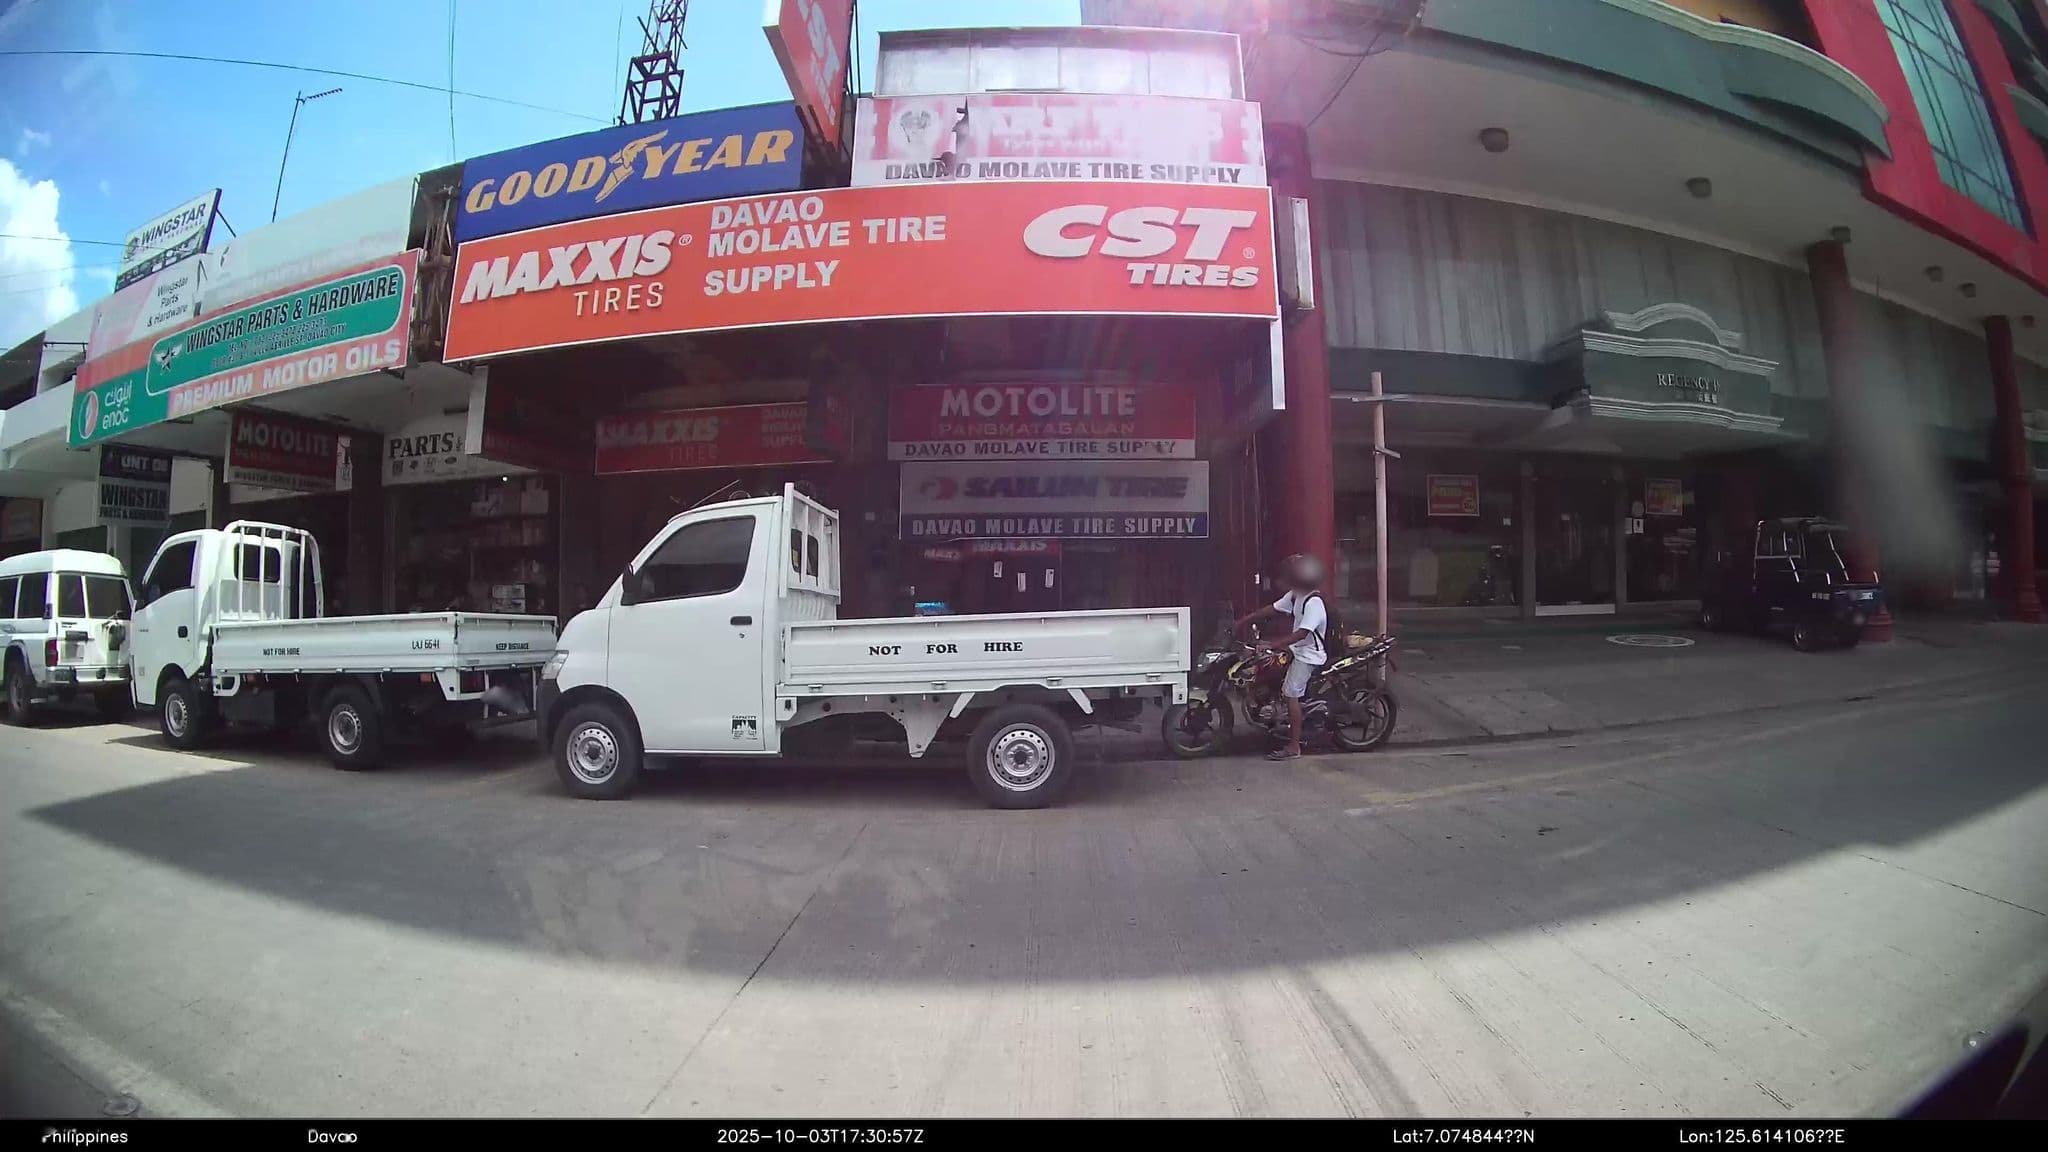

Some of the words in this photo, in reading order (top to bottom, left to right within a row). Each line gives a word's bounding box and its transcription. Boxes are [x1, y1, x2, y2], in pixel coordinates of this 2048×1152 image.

[979, 161, 1081, 179] MOLAVE
[1088, 162, 1144, 180] TIRE
[1151, 163, 1241, 184] SUPPLY
[141, 203, 206, 245] WINGSTAR
[711, 196, 824, 230] DAVAO
[708, 221, 850, 258] MOLAVE
[863, 215, 947, 244] TIRE
[1023, 204, 1257, 262] CST
[460, 230, 676, 304] MAXXIS
[704, 260, 841, 297] SUPPLY
[1126, 262, 1260, 288] TIRES
[161, 294, 179, 308] Parts
[186, 316, 244, 353] WINGSTAR
[247, 302, 289, 334] PARTS
[292, 299, 303, 320] &
[308, 272, 399, 316] HARDWARE
[574, 281, 664, 317] TIRES
[330, 323, 347, 336] CITY
[173, 373, 254, 411] PREMIUM
[262, 354, 338, 391] MOTOR
[345, 338, 400, 370] OILS
[940, 387, 1136, 418] MOTOLITE
[102, 409, 129, 431] enoc
[938, 421, 1136, 436] PANGMATAGALAN
[237, 418, 330, 455] MOTOLITE
[389, 431, 454, 459] PARTS
[905, 442, 966, 457] DAVAO
[974, 441, 1049, 455] MOLAVE
[1058, 441, 1098, 455] TIRE
[1106, 440, 1176, 454] SUPPLY
[1108, 475, 1190, 498] TIRE
[911, 518, 976, 535] DAVAO
[985, 518, 1064, 535] MOLAVE
[1071, 518, 1115, 534] TIRE
[1124, 517, 1196, 533] SUPPLY
[262, 648, 273, 656] NOT
[274, 647, 285, 656] FOR
[868, 644, 902, 656] NOT
[926, 643, 958, 655] FOR
[984, 641, 1024, 653] HIRE
